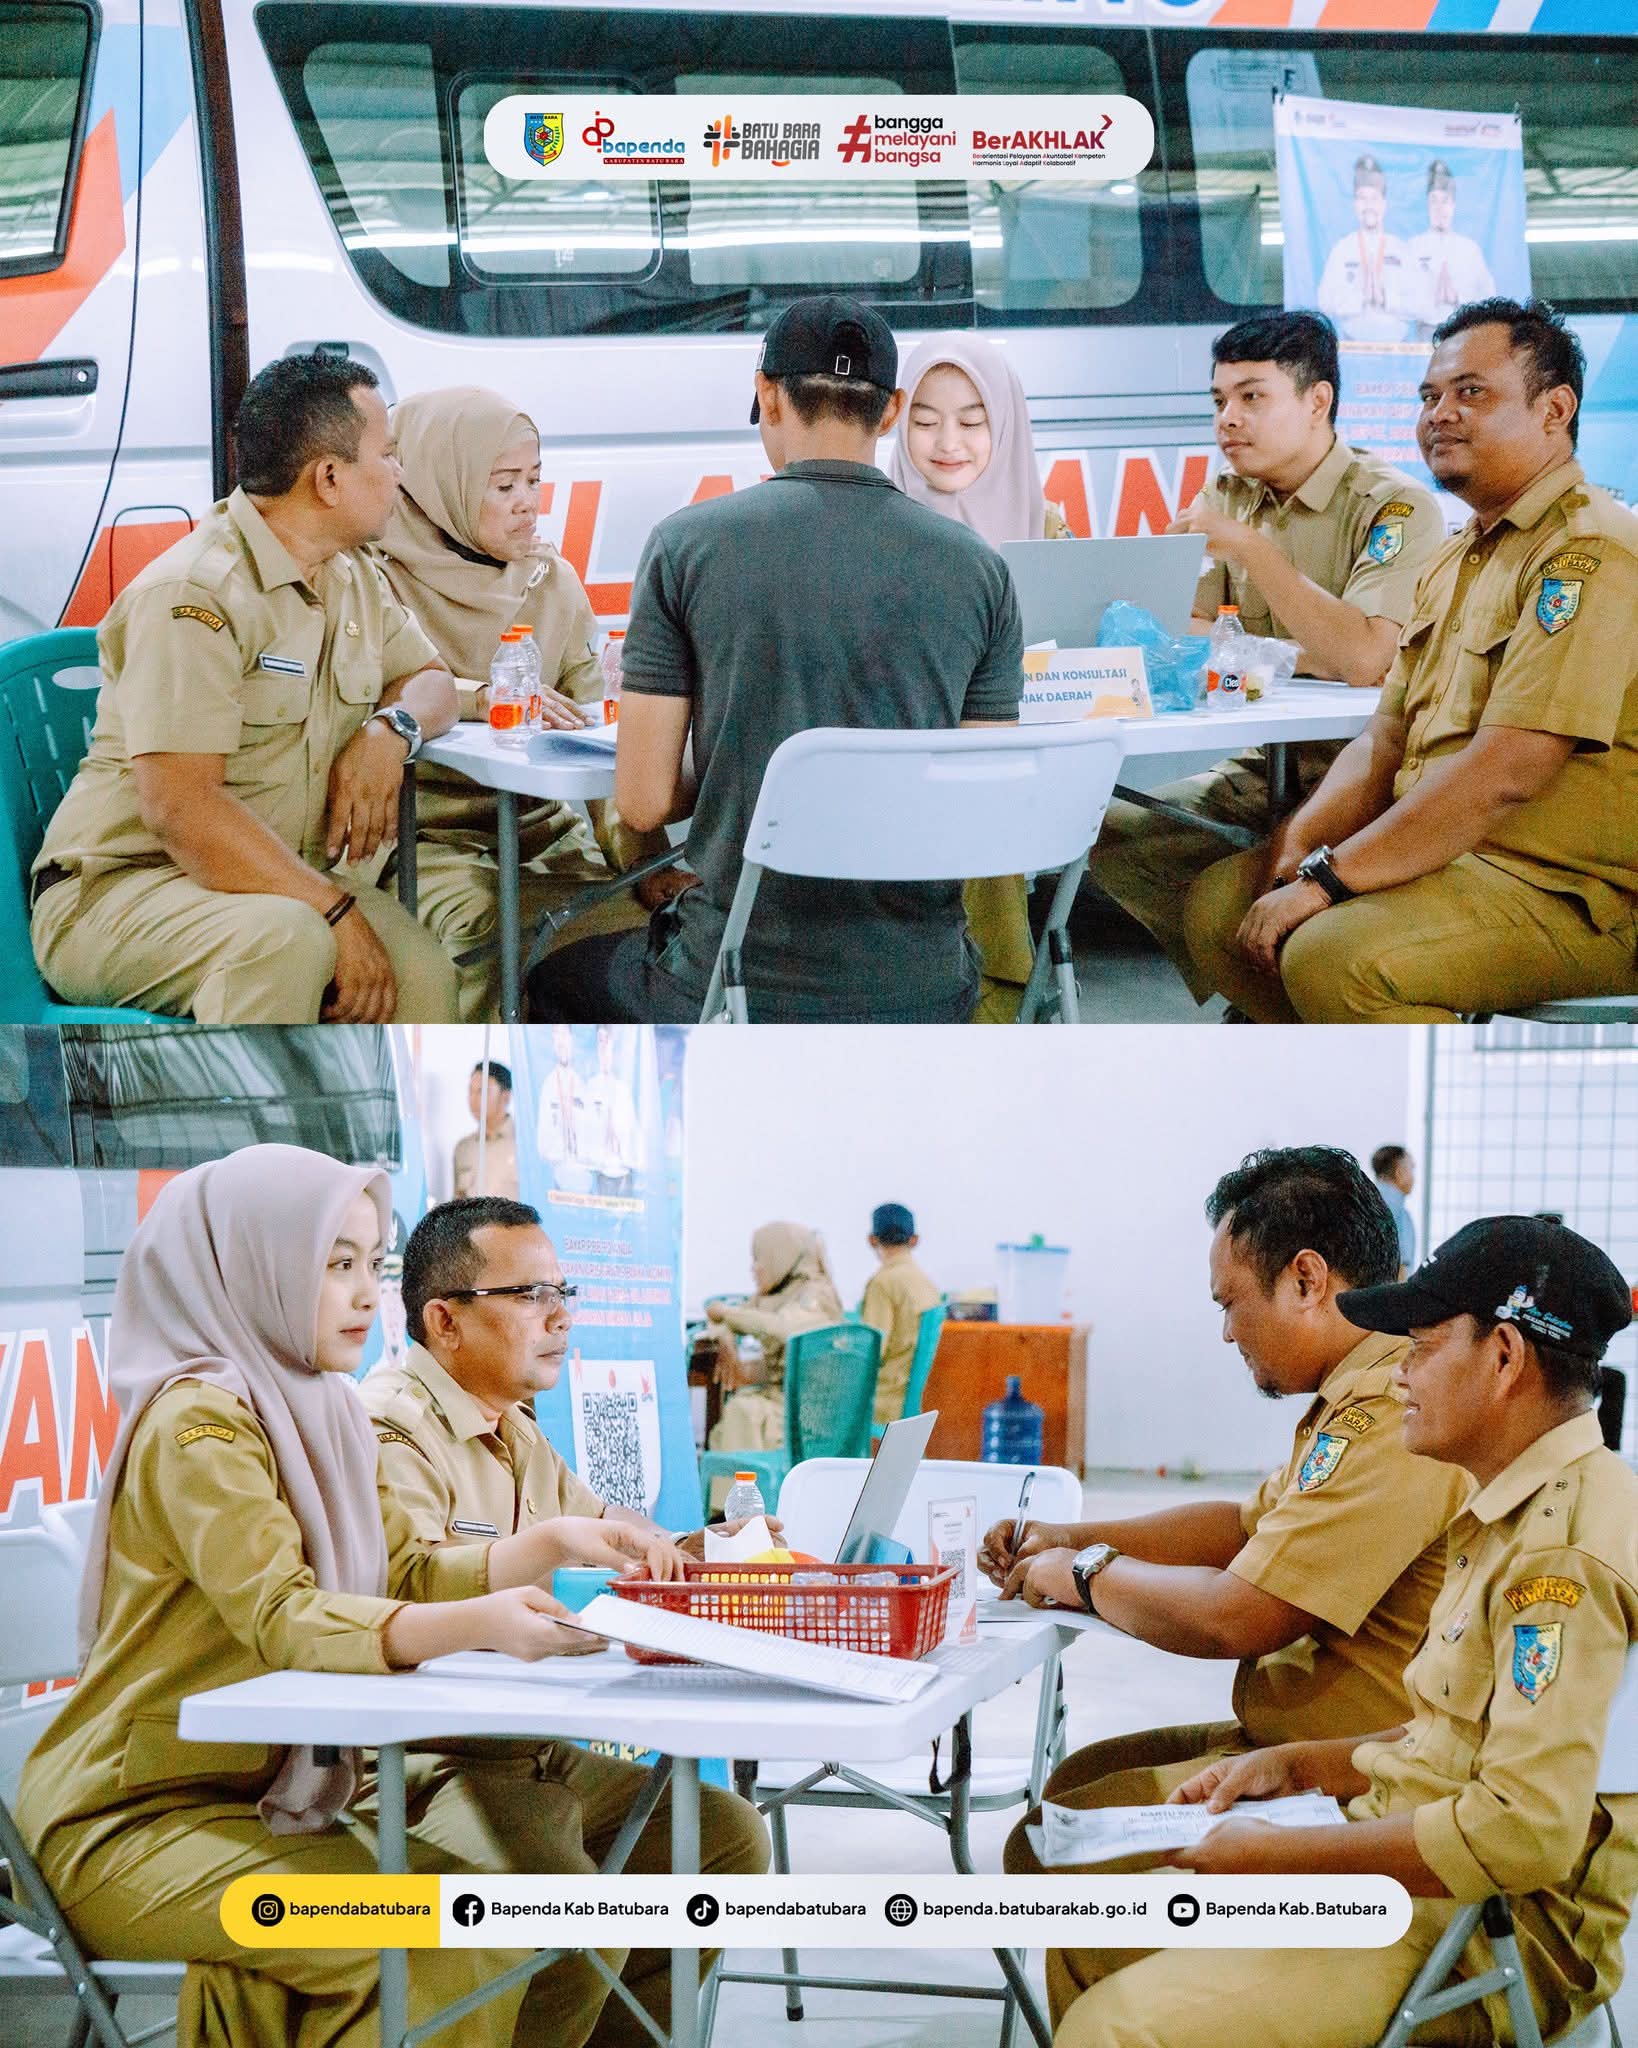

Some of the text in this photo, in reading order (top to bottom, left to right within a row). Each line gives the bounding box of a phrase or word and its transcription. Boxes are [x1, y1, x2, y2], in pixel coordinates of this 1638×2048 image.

[1036, 671, 1060, 682] DAN
[1062, 668, 1127, 681] KONSULTASI
[1021, 691, 1093, 705] JAK DAERAH
[178, 1426, 235, 1446] BAPENDA
